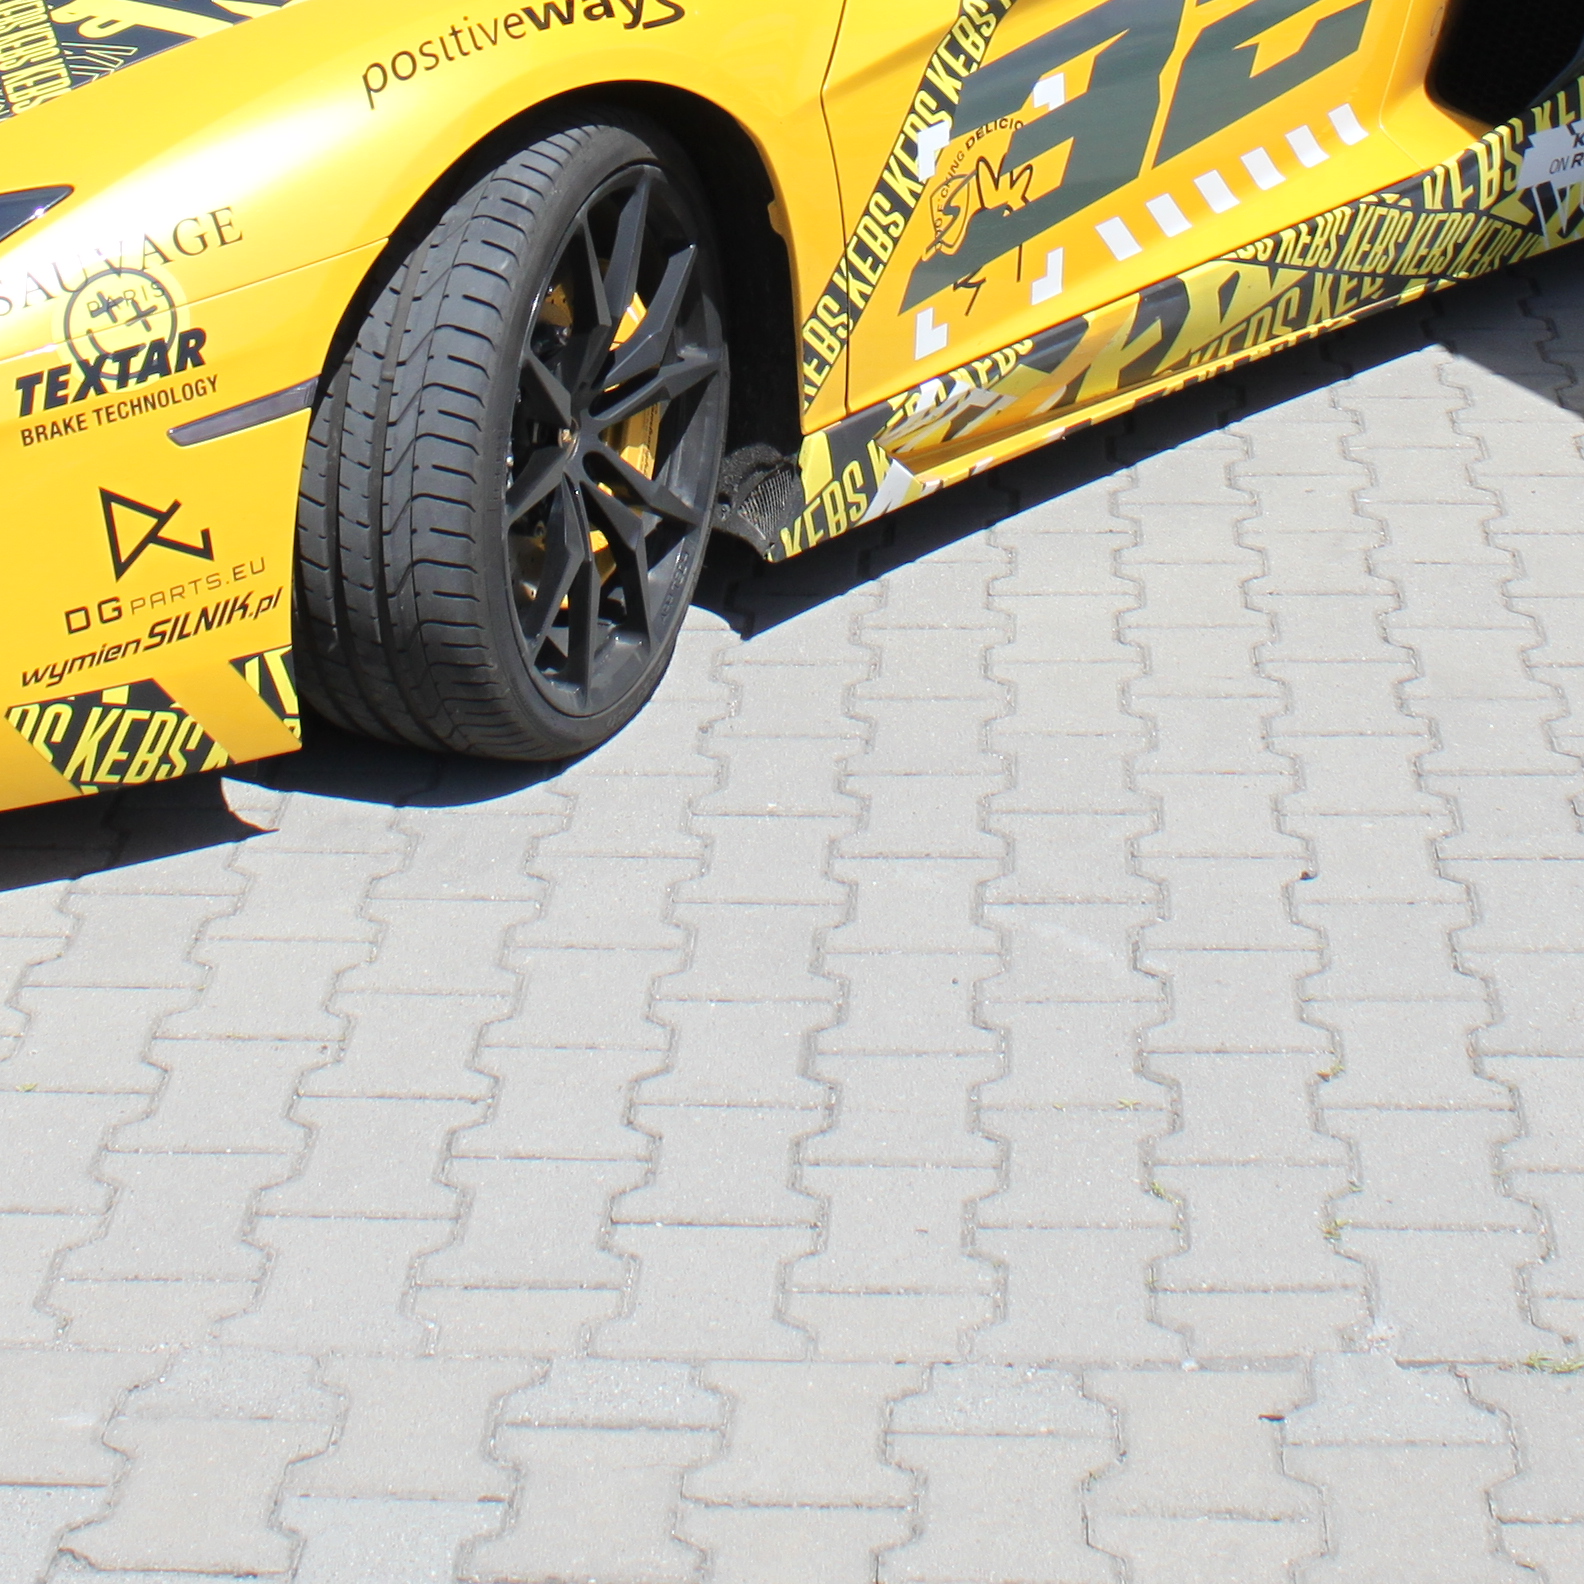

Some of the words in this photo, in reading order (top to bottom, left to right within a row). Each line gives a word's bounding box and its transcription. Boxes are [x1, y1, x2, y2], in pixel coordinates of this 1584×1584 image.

[965, 117, 1024, 151] DELICIO
[1549, 155, 1568, 175] ON
[832, 199, 905, 298] KEBS
[1395, 210, 1474, 277] KEBS
[86, 281, 167, 319] PARIS
[15, 327, 207, 418] TEXTAR
[21, 409, 89, 448] BRAKE
[96, 373, 219, 427] TECHNOLOGY
[67, 706, 205, 786] KEBS
